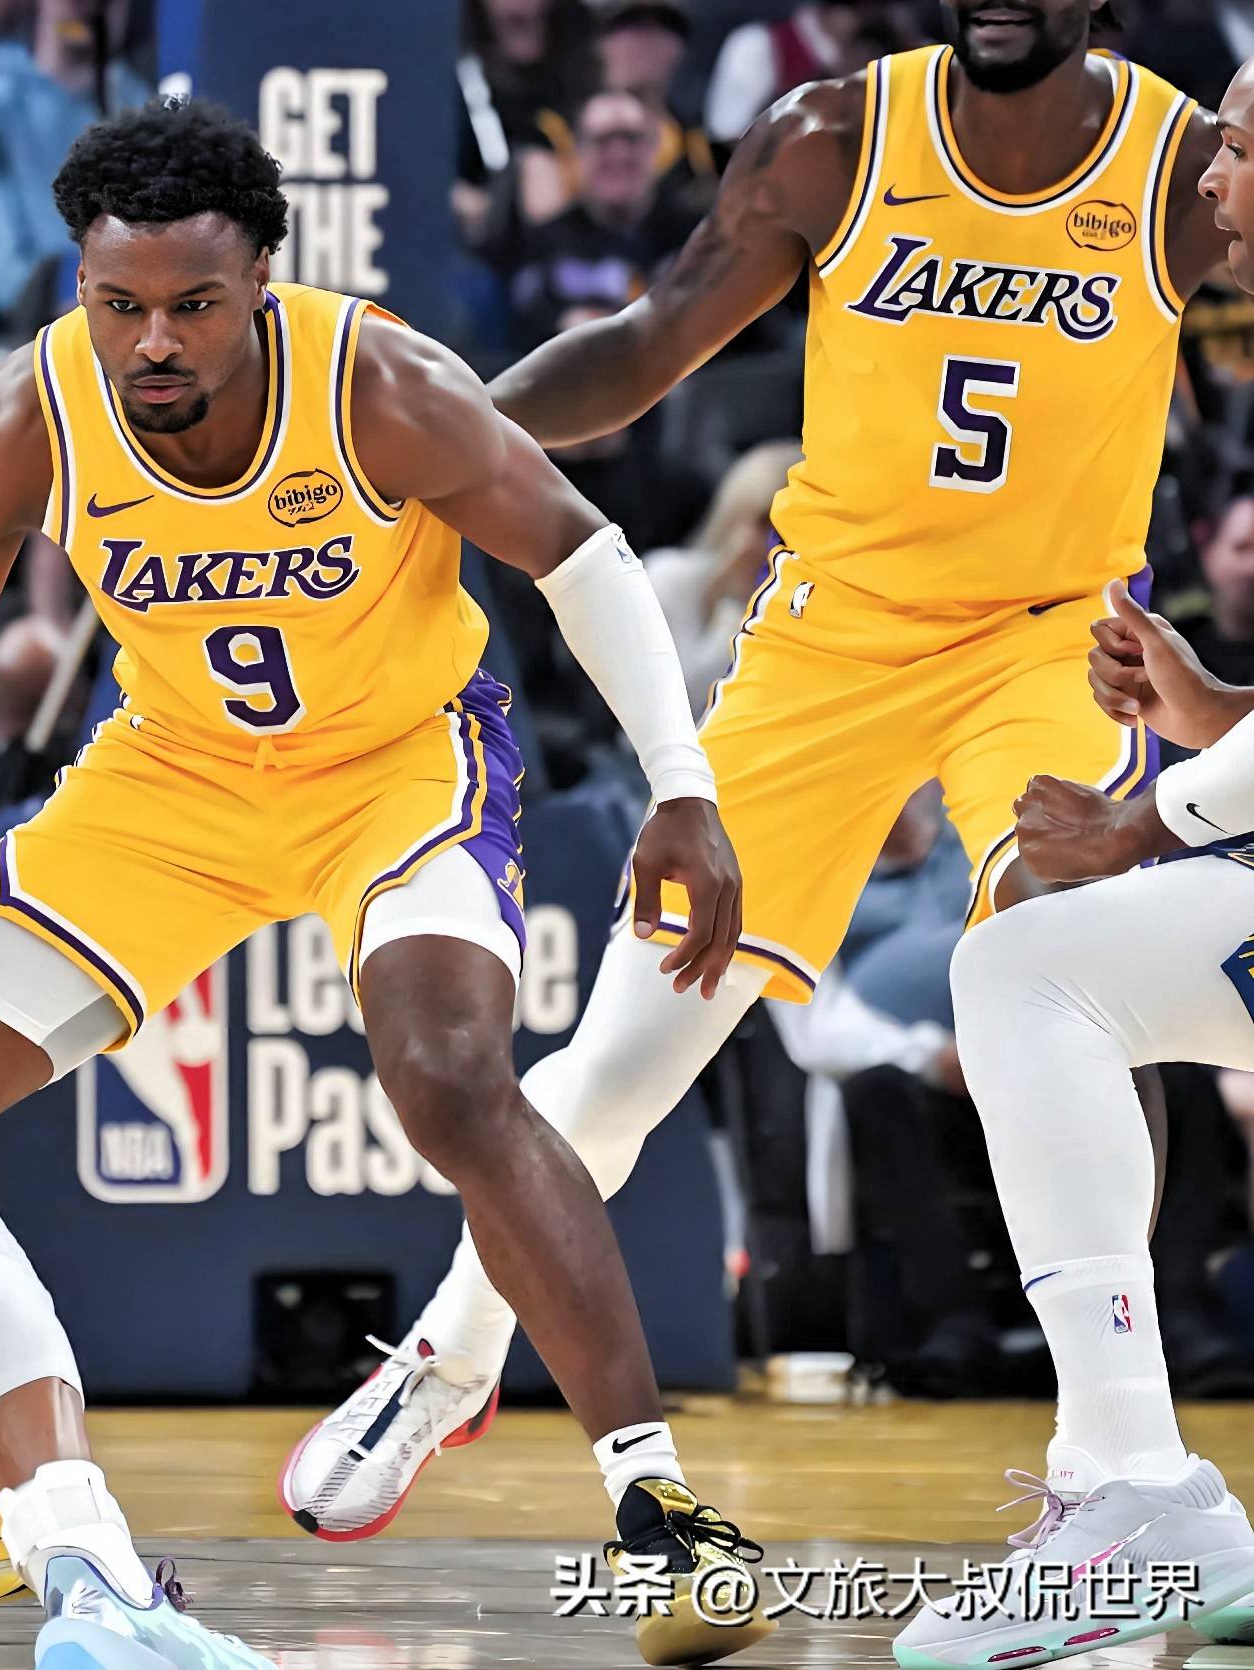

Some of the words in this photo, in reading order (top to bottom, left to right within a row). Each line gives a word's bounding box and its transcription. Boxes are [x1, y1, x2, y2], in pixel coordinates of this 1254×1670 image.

[258, 66, 389, 180] GET
[270, 182, 389, 296] THE
[1073, 211, 1132, 238] bibigo
[845, 234, 1122, 343] LAKERS
[929, 354, 1021, 494] 5
[273, 484, 338, 511] bibigo
[99, 534, 361, 614] LAKERS
[202, 625, 307, 736] 9
